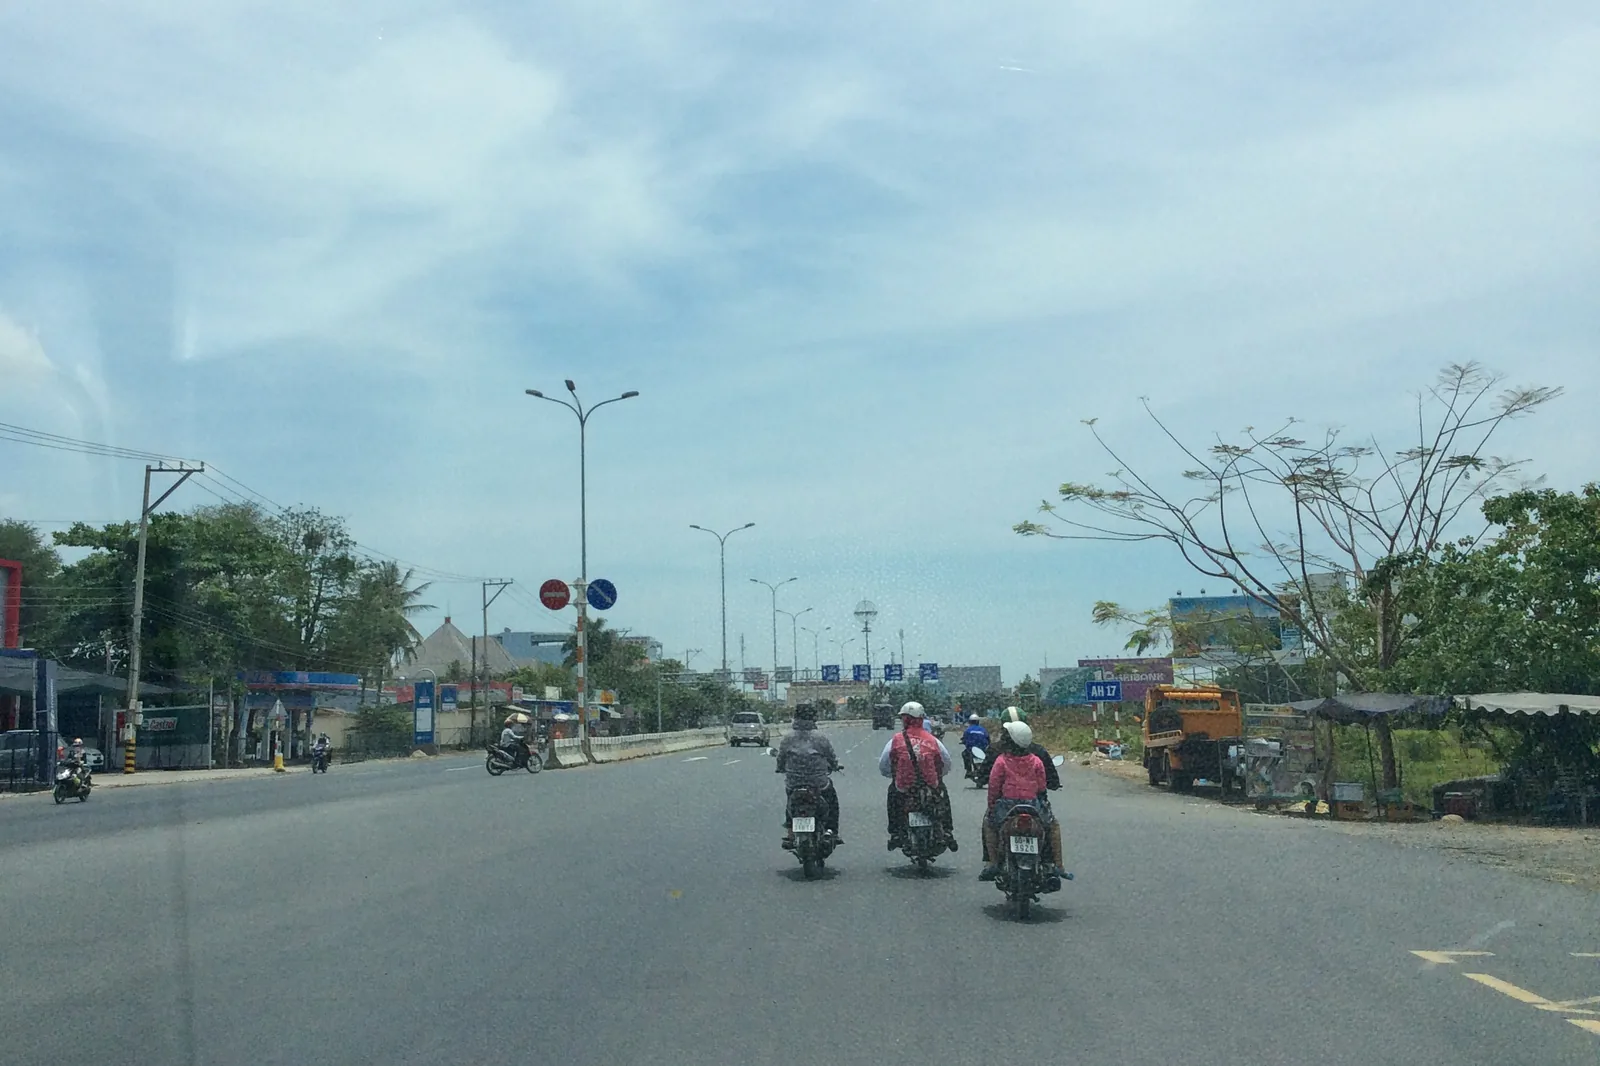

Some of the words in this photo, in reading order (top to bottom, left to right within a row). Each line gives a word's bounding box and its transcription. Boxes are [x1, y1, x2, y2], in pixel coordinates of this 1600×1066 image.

[1115, 672, 1164, 682] GRIBANK
[1091, 685, 1104, 697] AH
[1106, 685, 1117, 697] 17
[149, 719, 176, 730] Castrol
